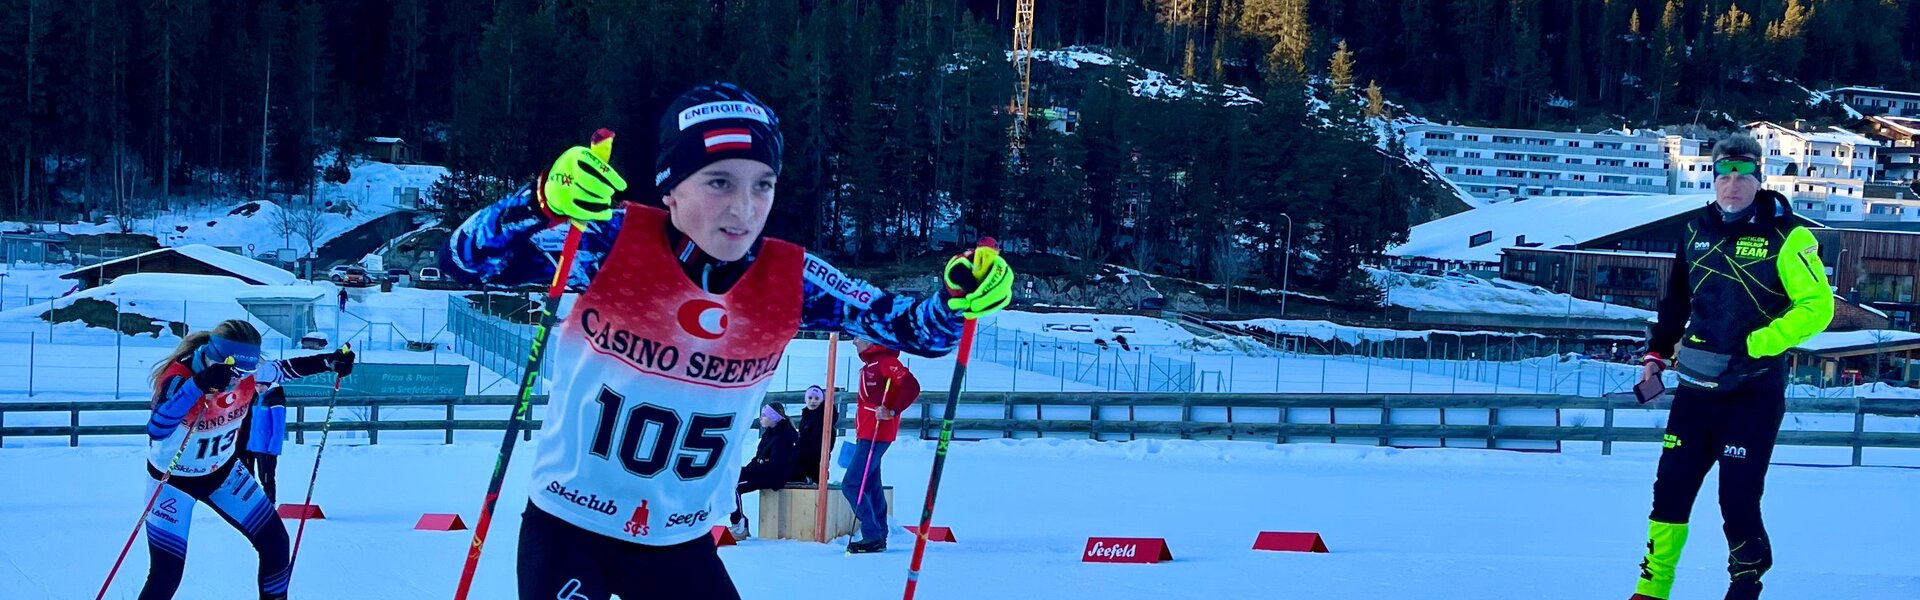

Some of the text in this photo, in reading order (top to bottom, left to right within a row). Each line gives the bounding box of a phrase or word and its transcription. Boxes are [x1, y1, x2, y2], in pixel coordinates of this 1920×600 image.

[1735, 246, 1768, 259] TEAM
[581, 308, 679, 372] CASINO
[382, 373, 404, 382] Pizza
[406, 374, 413, 382] &
[438, 386, 454, 395] See
[196, 428, 239, 460] 113
[589, 383, 736, 481] 105
[546, 481, 618, 516] Skiclub
[1087, 541, 1137, 560] Seefeld
